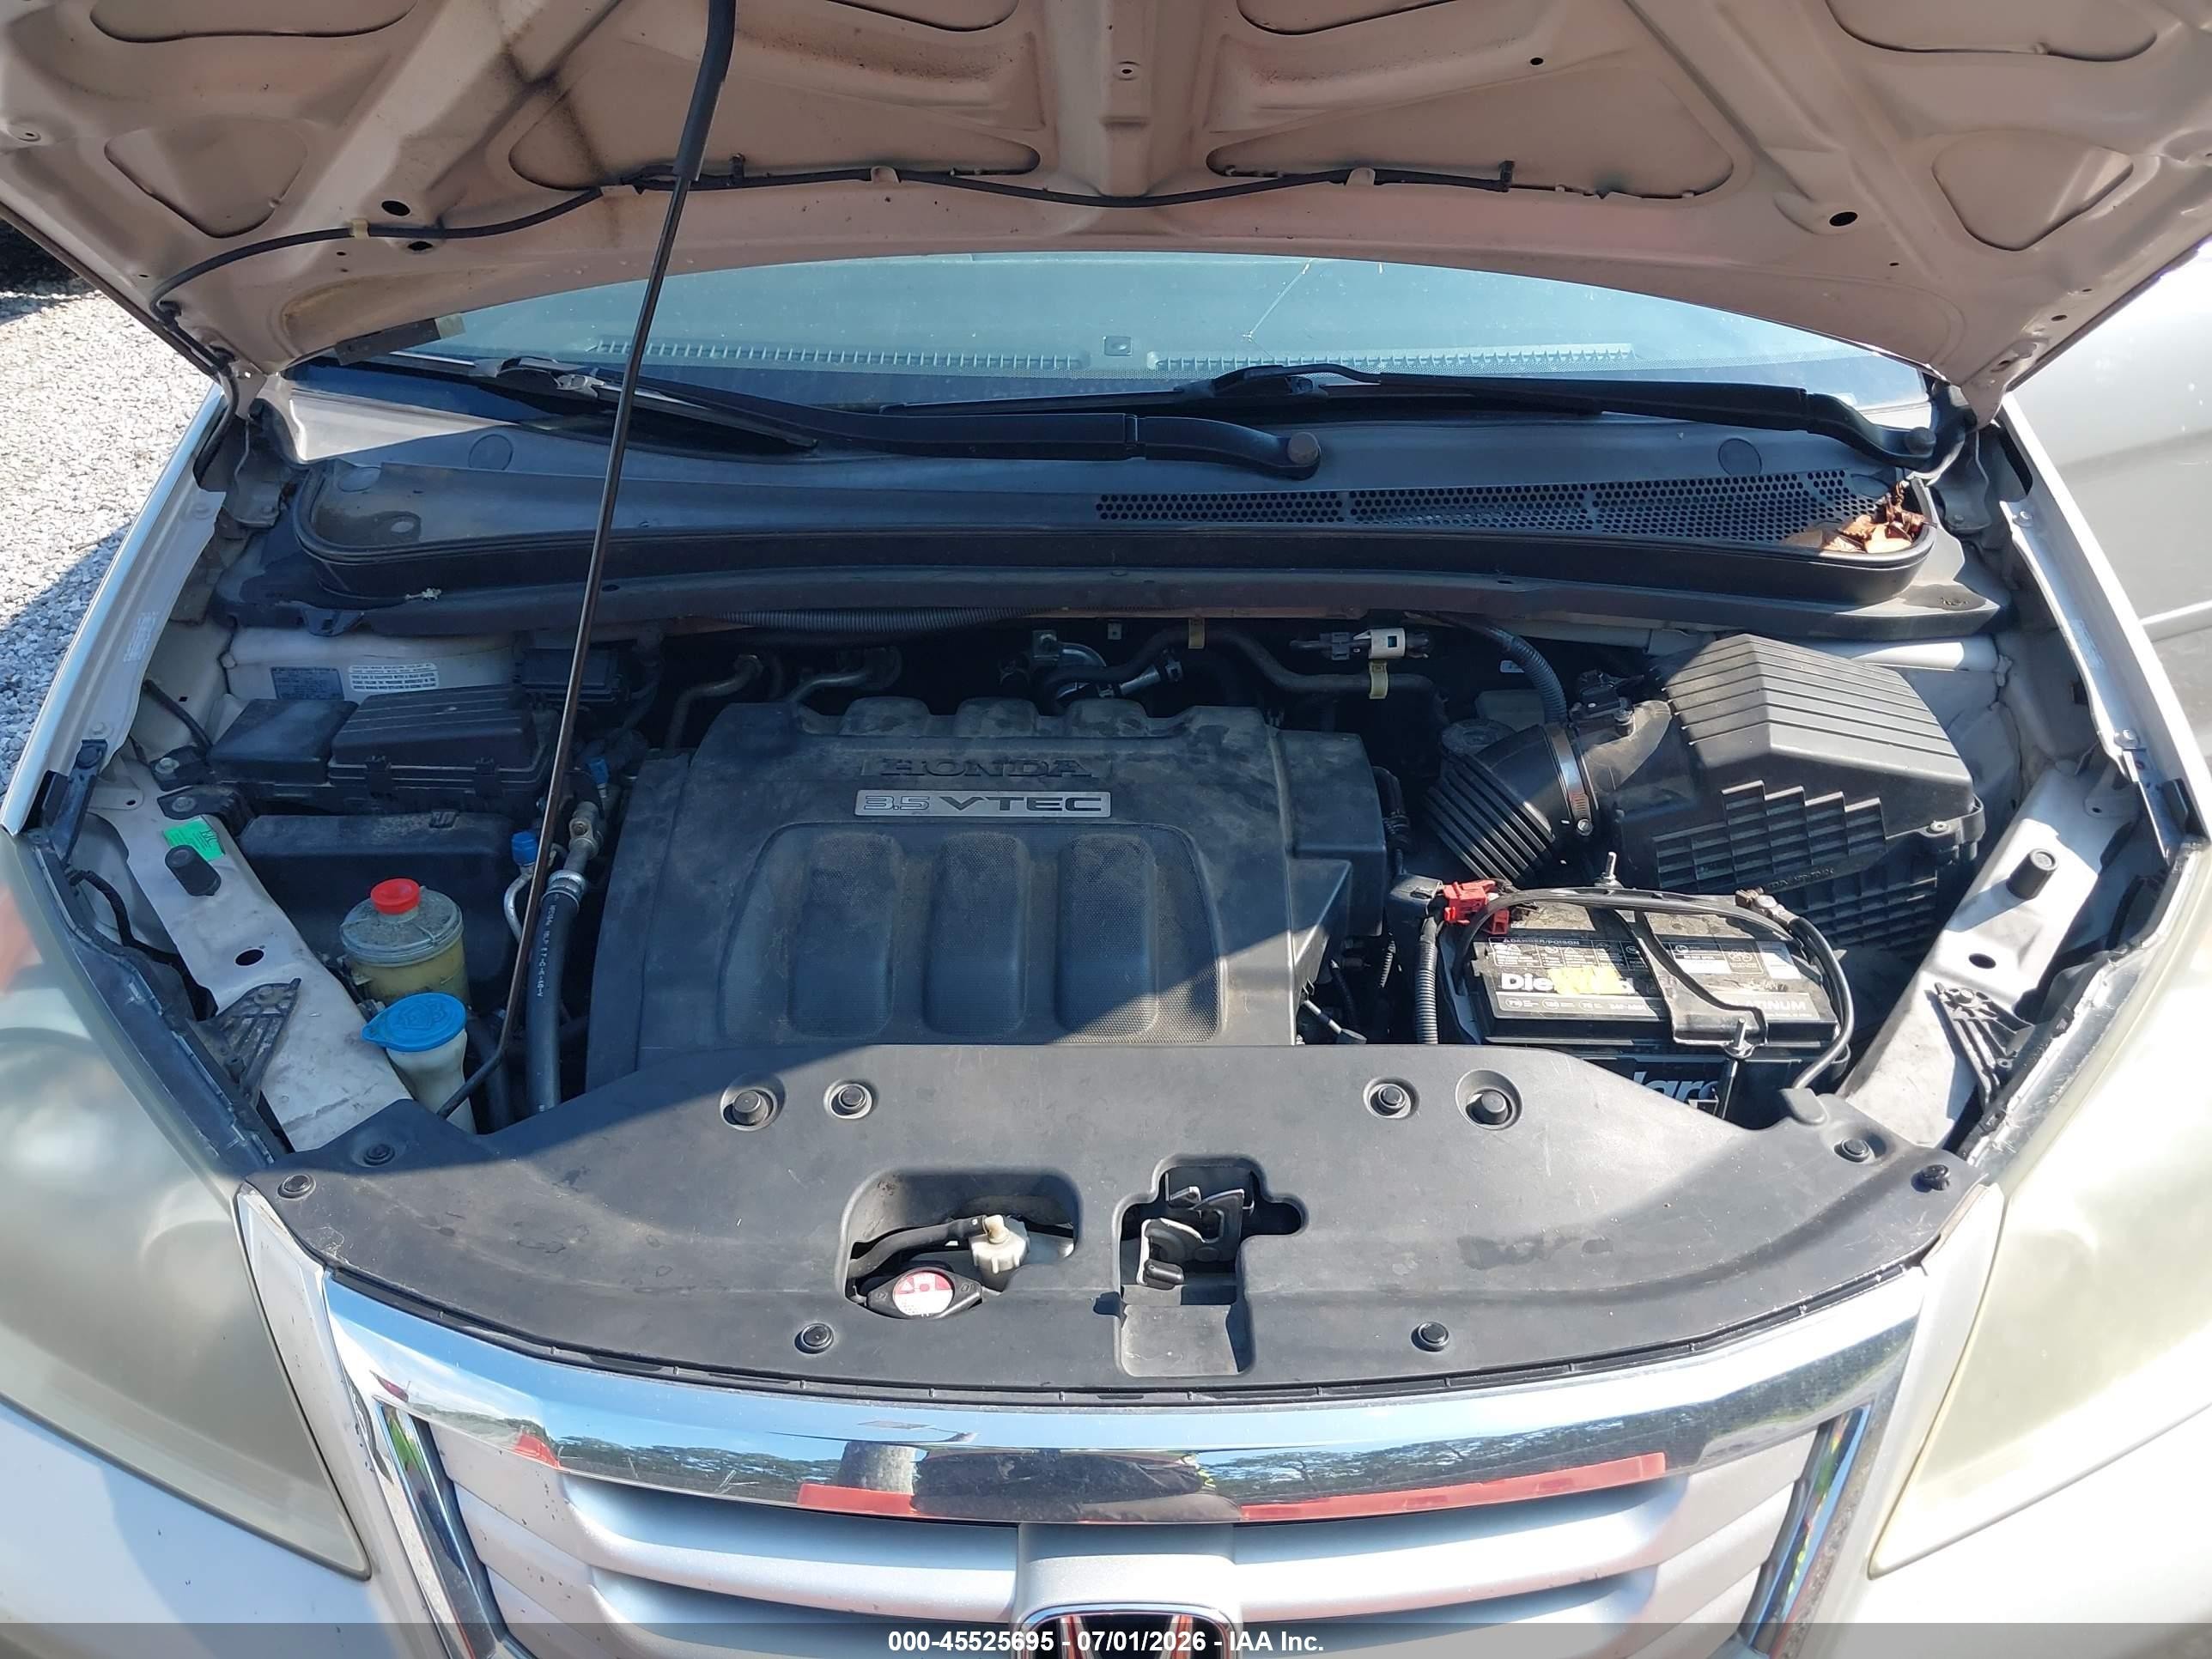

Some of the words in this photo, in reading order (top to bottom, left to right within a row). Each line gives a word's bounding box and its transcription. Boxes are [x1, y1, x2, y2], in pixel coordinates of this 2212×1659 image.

[880, 757, 1092, 778] HONDA
[863, 795, 931, 811] 3.5
[939, 795, 1103, 811] VTEC
